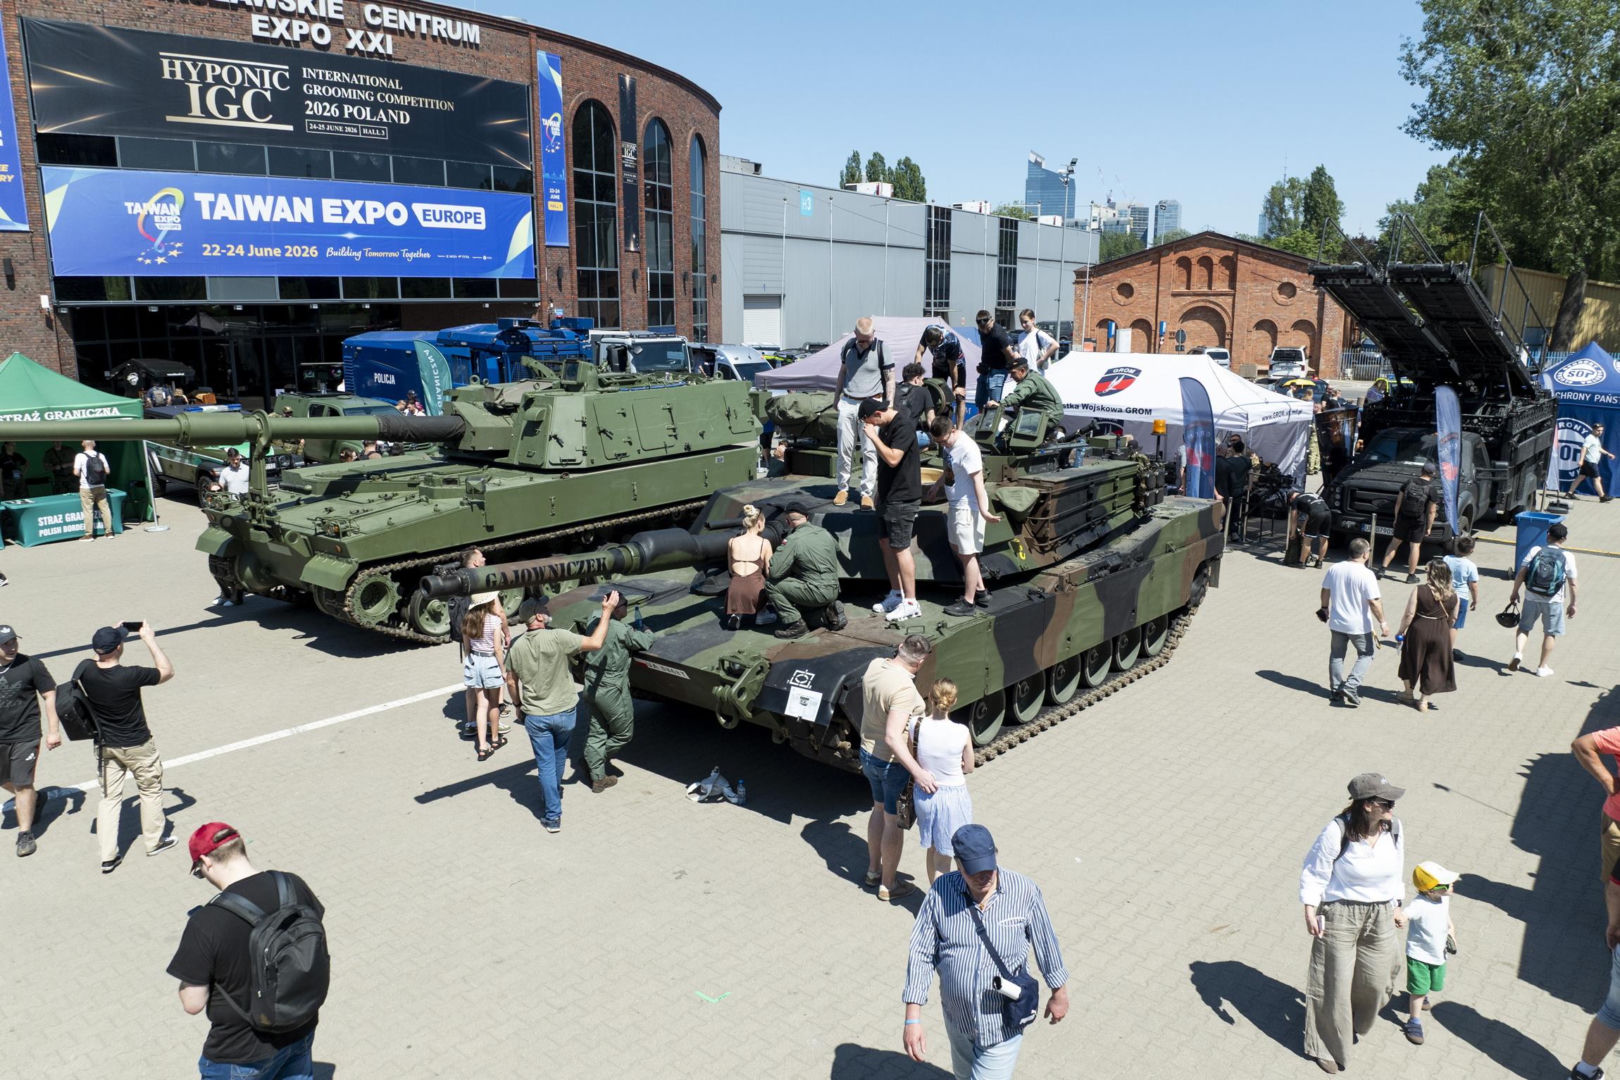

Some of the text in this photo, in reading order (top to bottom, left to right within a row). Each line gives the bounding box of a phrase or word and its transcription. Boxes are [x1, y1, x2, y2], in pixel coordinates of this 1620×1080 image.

[364, 4, 480, 44] CENTRUM
[251, 13, 393, 55] EXPO XXI
[160, 58, 290, 91] HYPONIC
[302, 67, 403, 90] INTERNATIONAL
[185, 82, 273, 123] IGC
[302, 84, 455, 111] GROOMING COMPETITION
[304, 100, 411, 125] 2026 POLAND
[344, 126, 358, 134] 2026
[124, 201, 181, 216] TAIWAN
[193, 192, 482, 226] TAIWAN EXPO EUROPE
[154, 215, 181, 223] EXPO
[202, 244, 319, 258] 22-24 June 2026
[326, 246, 362, 262] Building
[363, 248, 400, 258] Tomorrow
[400, 248, 432, 262] Together
[374, 372, 396, 384] POLICJA
[44, 406, 120, 420] GRANICZNA
[1082, 403, 1123, 412] Wojskowa
[1126, 406, 1153, 416] GROM
[63, 523, 86, 533] BORDE
[485, 557, 608, 588] GAJOWNICZEK
